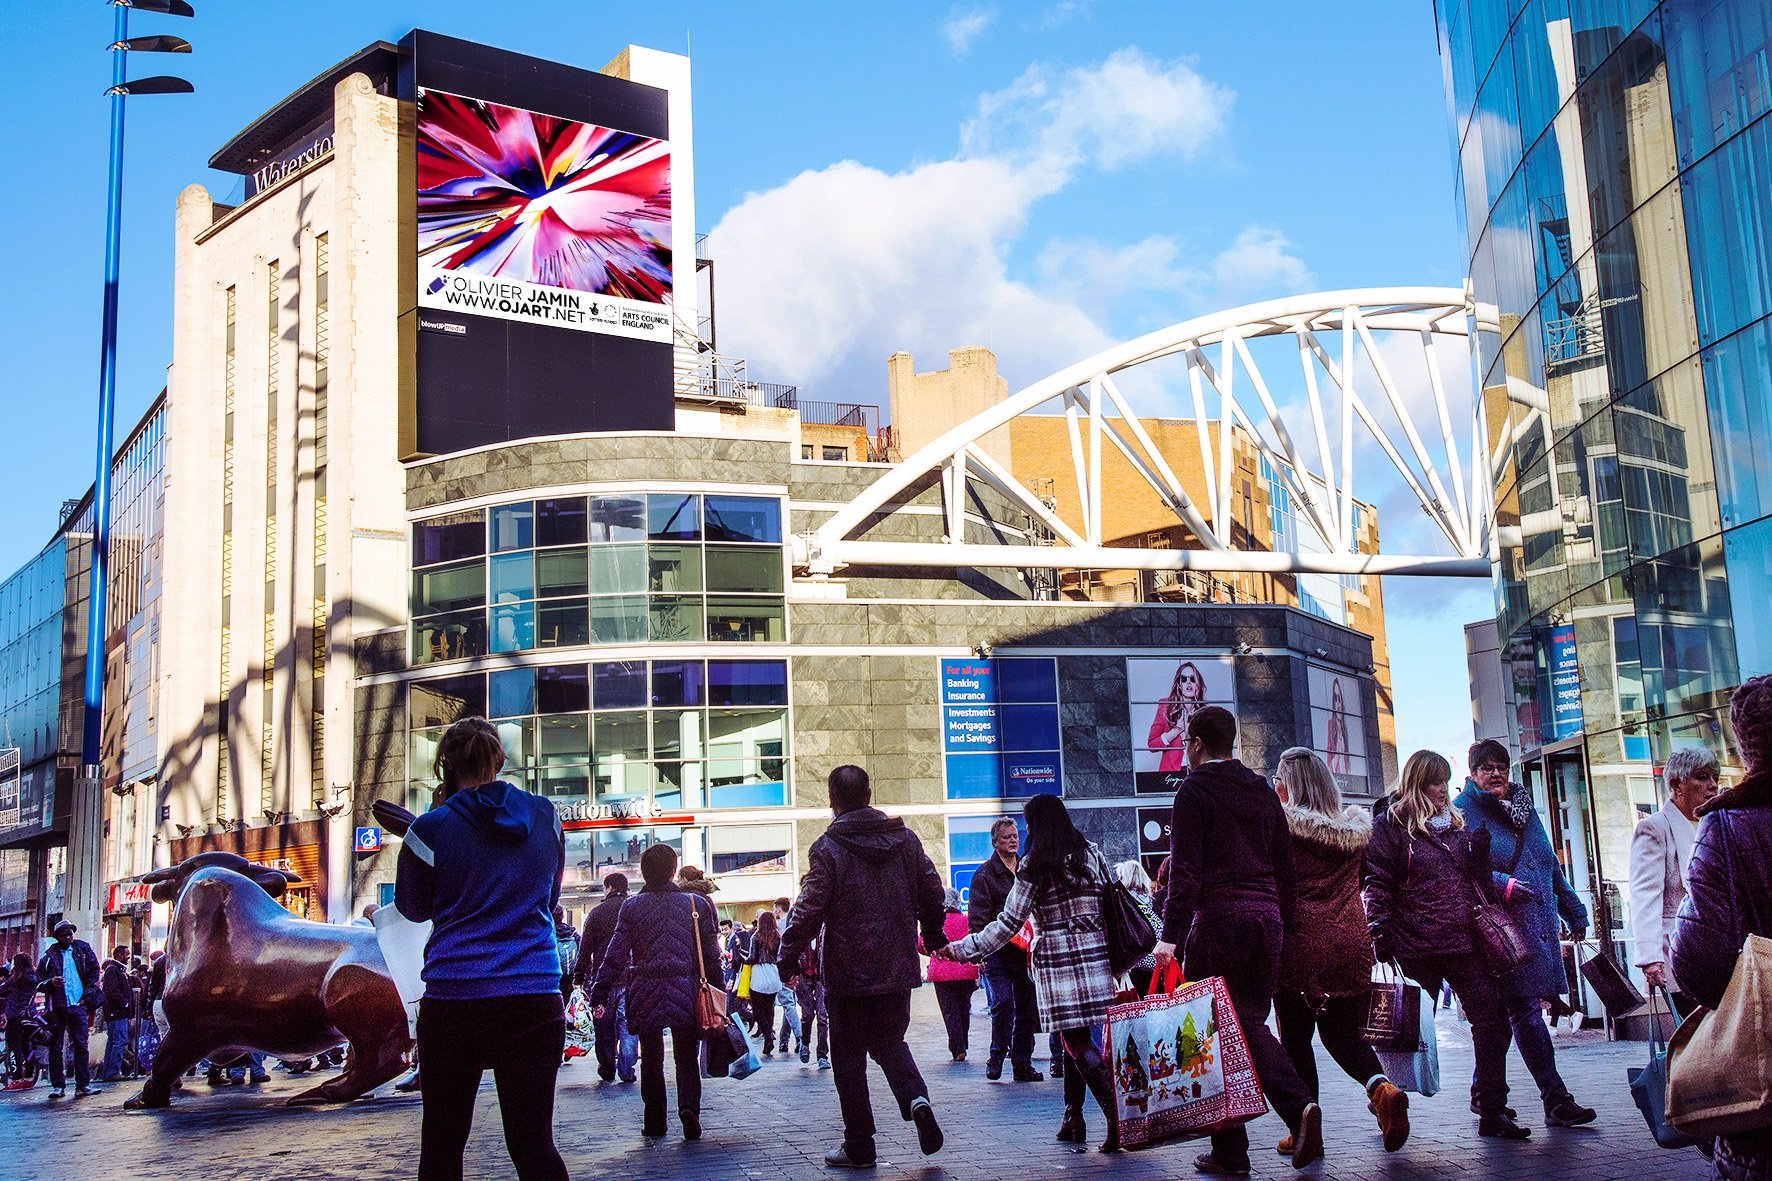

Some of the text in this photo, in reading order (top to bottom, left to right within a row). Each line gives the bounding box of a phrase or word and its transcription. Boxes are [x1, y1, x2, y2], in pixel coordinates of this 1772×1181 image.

[453, 277, 580, 309] OLIVIER JAMIN
[445, 290, 586, 323] WWW.OJART.NET
[622, 312, 669, 325] ARTS COUNCIL
[622, 319, 654, 330] ENGLAND
[946, 665, 991, 676] For all your
[947, 679, 979, 690] Banking
[948, 691, 985, 700] Insurance
[949, 708, 996, 717] Investments
[950, 721, 991, 732] Mortgages
[950, 733, 996, 744] and Savings
[1020, 767, 1053, 775] Nationwide
